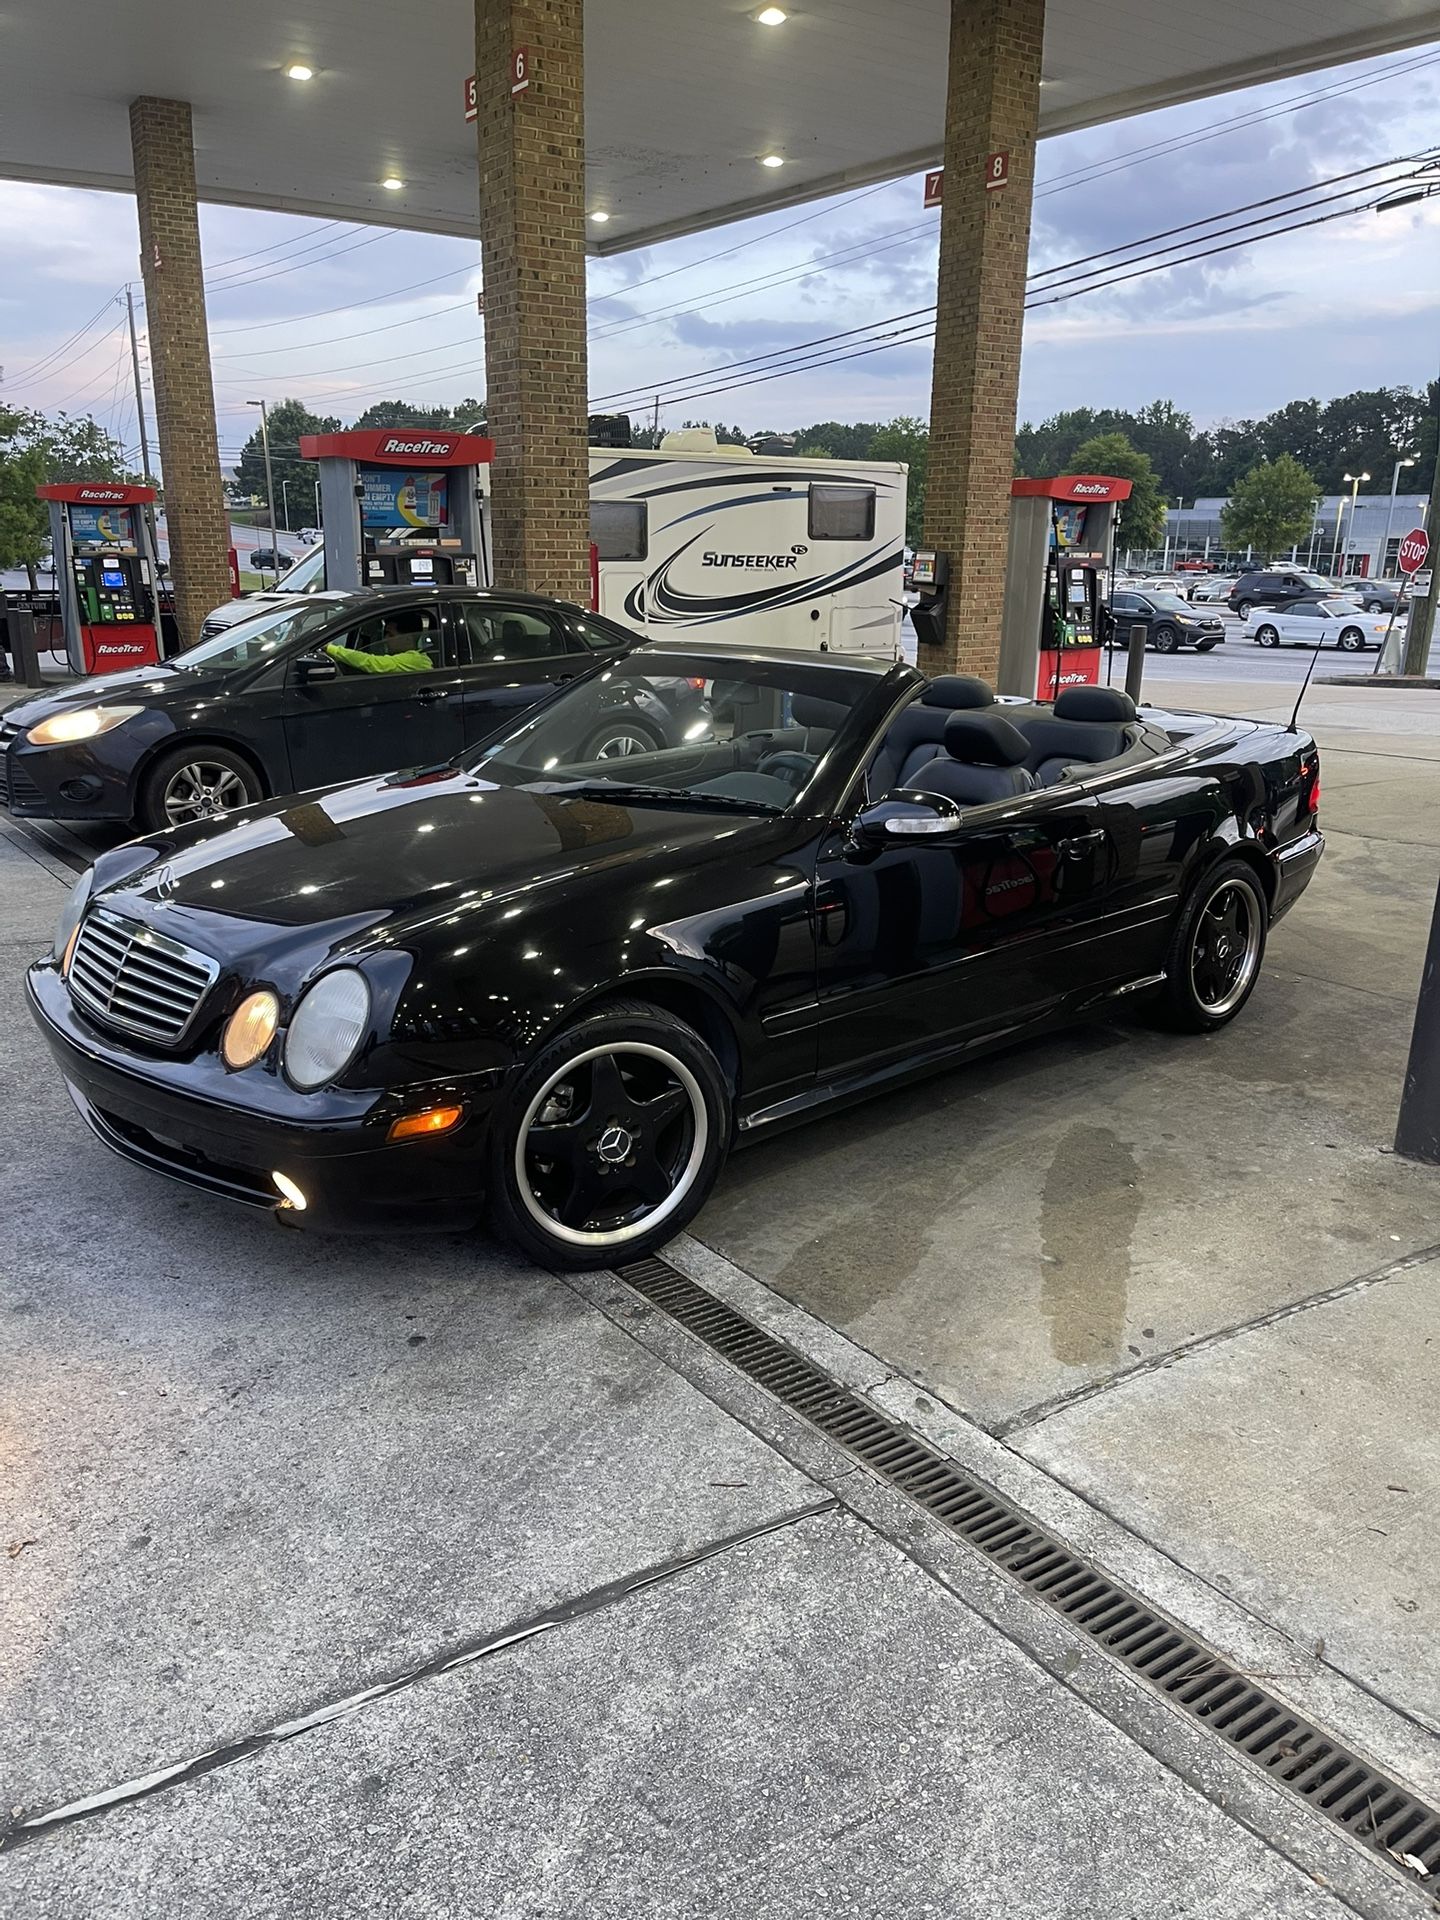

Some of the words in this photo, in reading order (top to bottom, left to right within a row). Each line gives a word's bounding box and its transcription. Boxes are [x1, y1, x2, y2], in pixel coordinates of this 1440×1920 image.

[516, 53, 524, 79] 6
[469, 81, 477, 105] 5
[993, 156, 1003, 177] 8
[930, 175, 940, 195] 7
[384, 439, 450, 454] RaceTrac
[80, 490, 125, 499] RaceTrac
[364, 484, 391, 492] UMMER
[1073, 483, 1110, 495] RaceTrac
[793, 545, 807, 554] TS
[1401, 540, 1427, 560] STOP
[17, 602, 47, 610] CENTURY
[98, 644, 144, 654] RaceTrac
